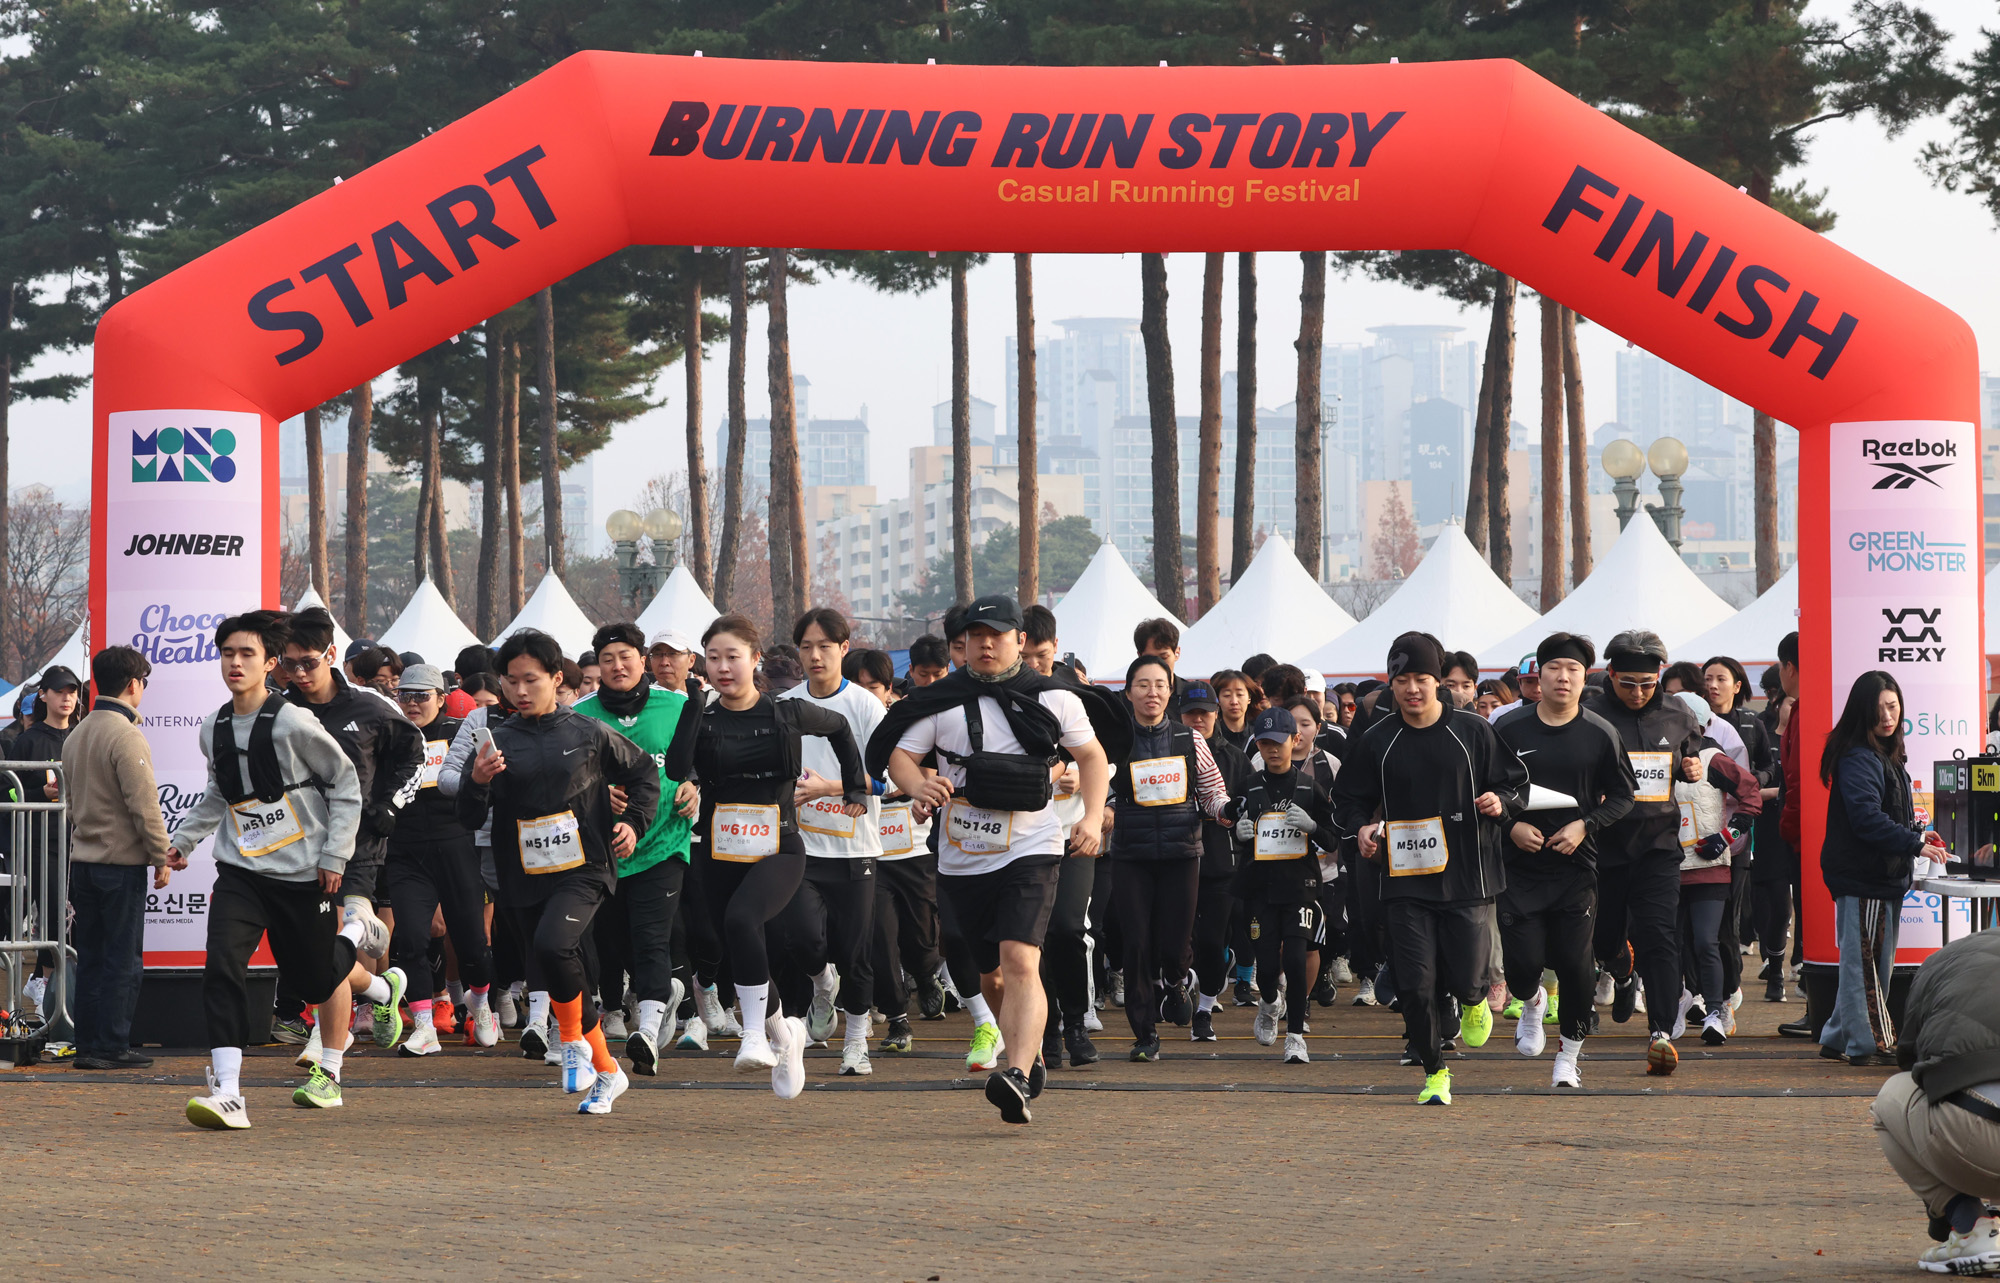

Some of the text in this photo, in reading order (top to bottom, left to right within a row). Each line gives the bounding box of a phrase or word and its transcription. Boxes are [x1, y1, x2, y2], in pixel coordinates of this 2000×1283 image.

[649, 100, 1406, 169] BURNING RUN STORY
[997, 178, 1360, 208] Casual Running Festival
[247, 144, 557, 366] START
[1541, 164, 1859, 381] FINISH
[1862, 438, 1957, 461] Reebok
[124, 533, 244, 557] JOHNBER
[1848, 531, 1925, 551] GREEN
[1867, 552, 1966, 572] MONSTER
[1878, 647, 1946, 662] REXY
[1140, 772, 1181, 785] W6208
[1977, 768, 1995, 787] 5km
[720, 823, 770, 836] W6103
[954, 816, 1002, 835] M5148
[1262, 828, 1302, 839] M5176
[525, 832, 571, 849] M5145
[1397, 837, 1437, 850] M5140
[1298, 906, 1314, 930] 10
